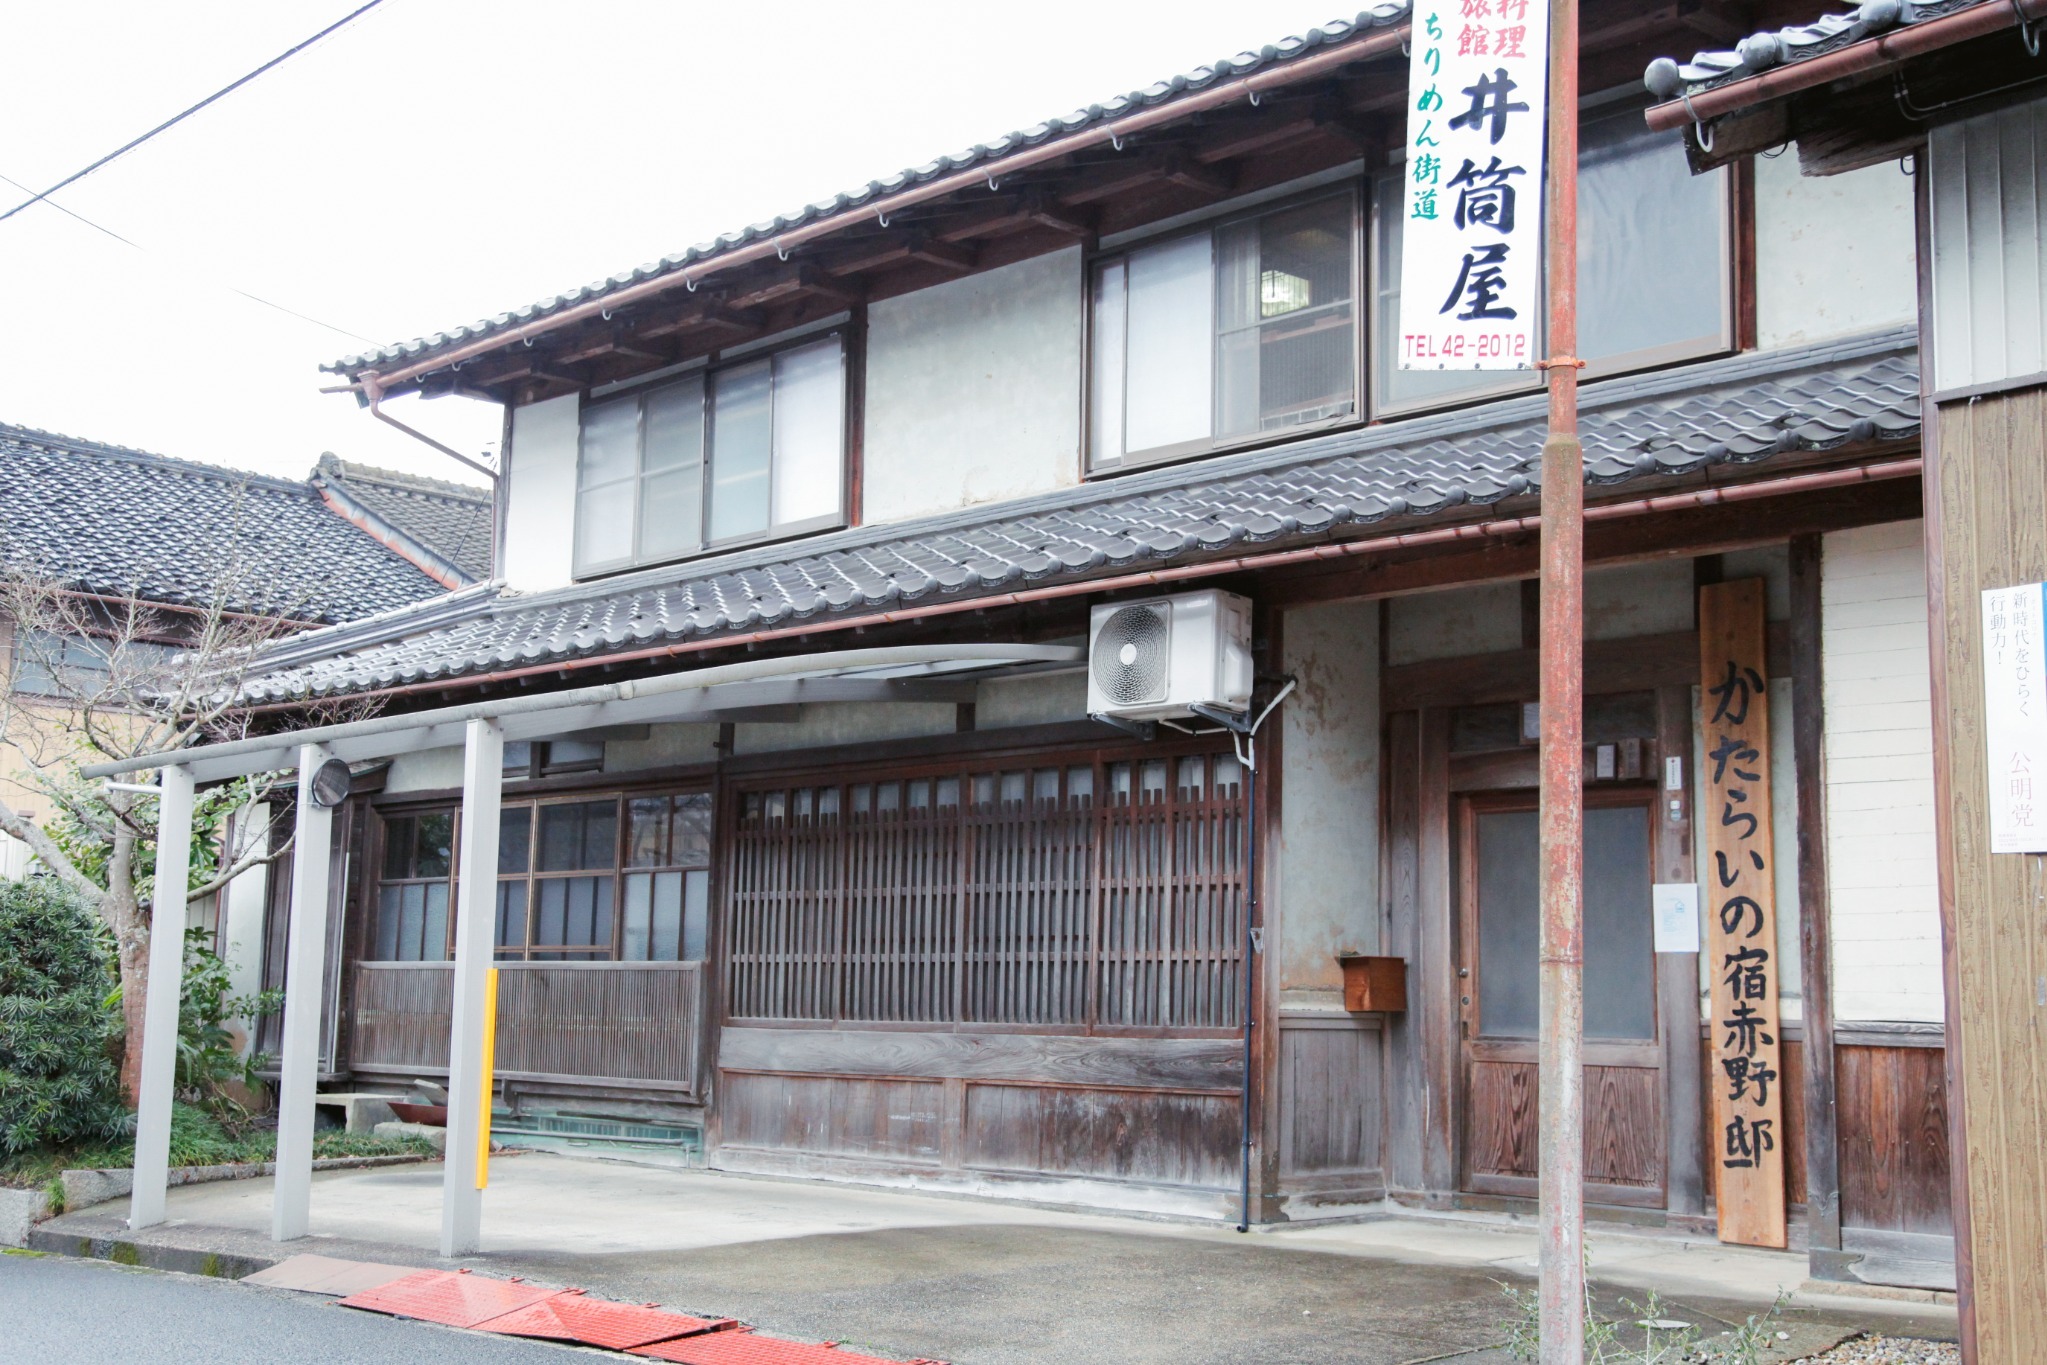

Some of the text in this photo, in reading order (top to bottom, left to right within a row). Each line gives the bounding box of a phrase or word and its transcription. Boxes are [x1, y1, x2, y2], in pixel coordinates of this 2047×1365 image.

[1410, 12, 1443, 220] ちりめん街道
[1439, 67, 1530, 322] 井筒屋
[1990, 595, 2007, 665] 行動力！
[2013, 592, 2030, 717] 新時代をひらく
[2009, 751, 2034, 828] 公明党
[1708, 660, 1777, 1169] かたらいの宿赤野邸
